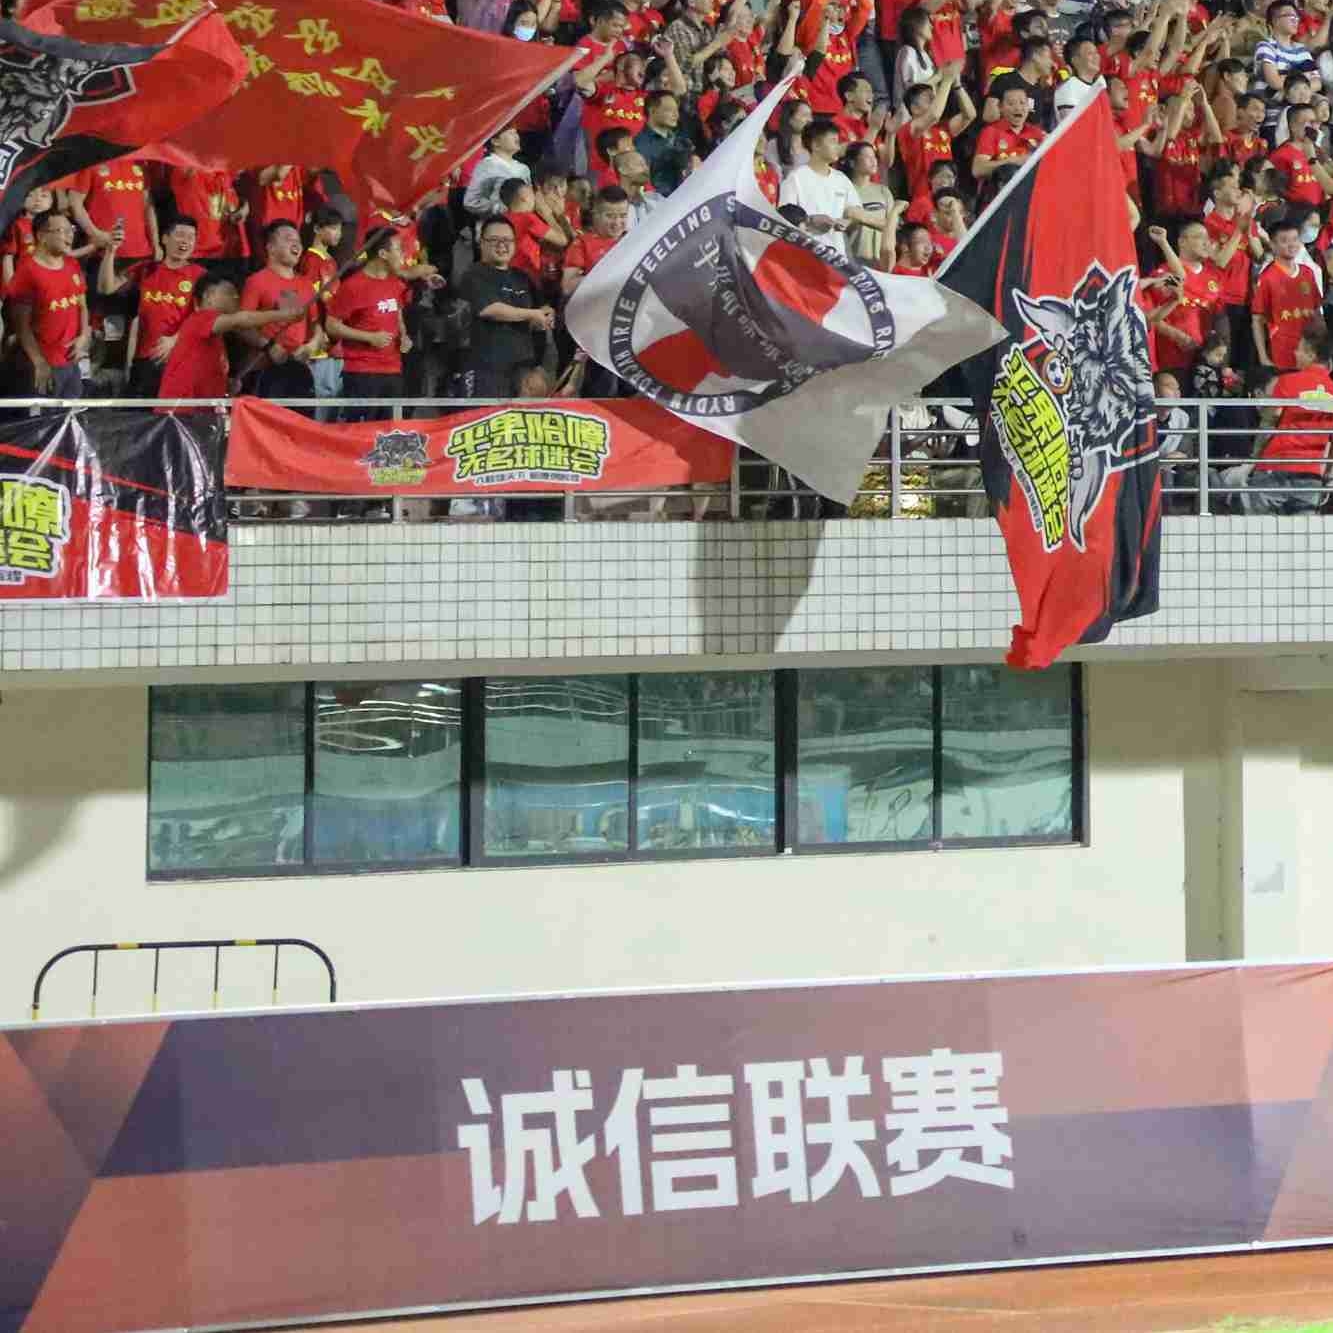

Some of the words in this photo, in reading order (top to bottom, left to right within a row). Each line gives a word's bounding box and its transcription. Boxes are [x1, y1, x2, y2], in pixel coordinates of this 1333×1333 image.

[611, 298, 637, 344] IRIE
[634, 205, 713, 287] FEELING
[450, 412, 607, 454] 平果哈嘹
[457, 444, 600, 478] 无名球迷会
[0, 528, 51, 572] 会
[458, 1046, 1014, 1226] 诚信联赛
